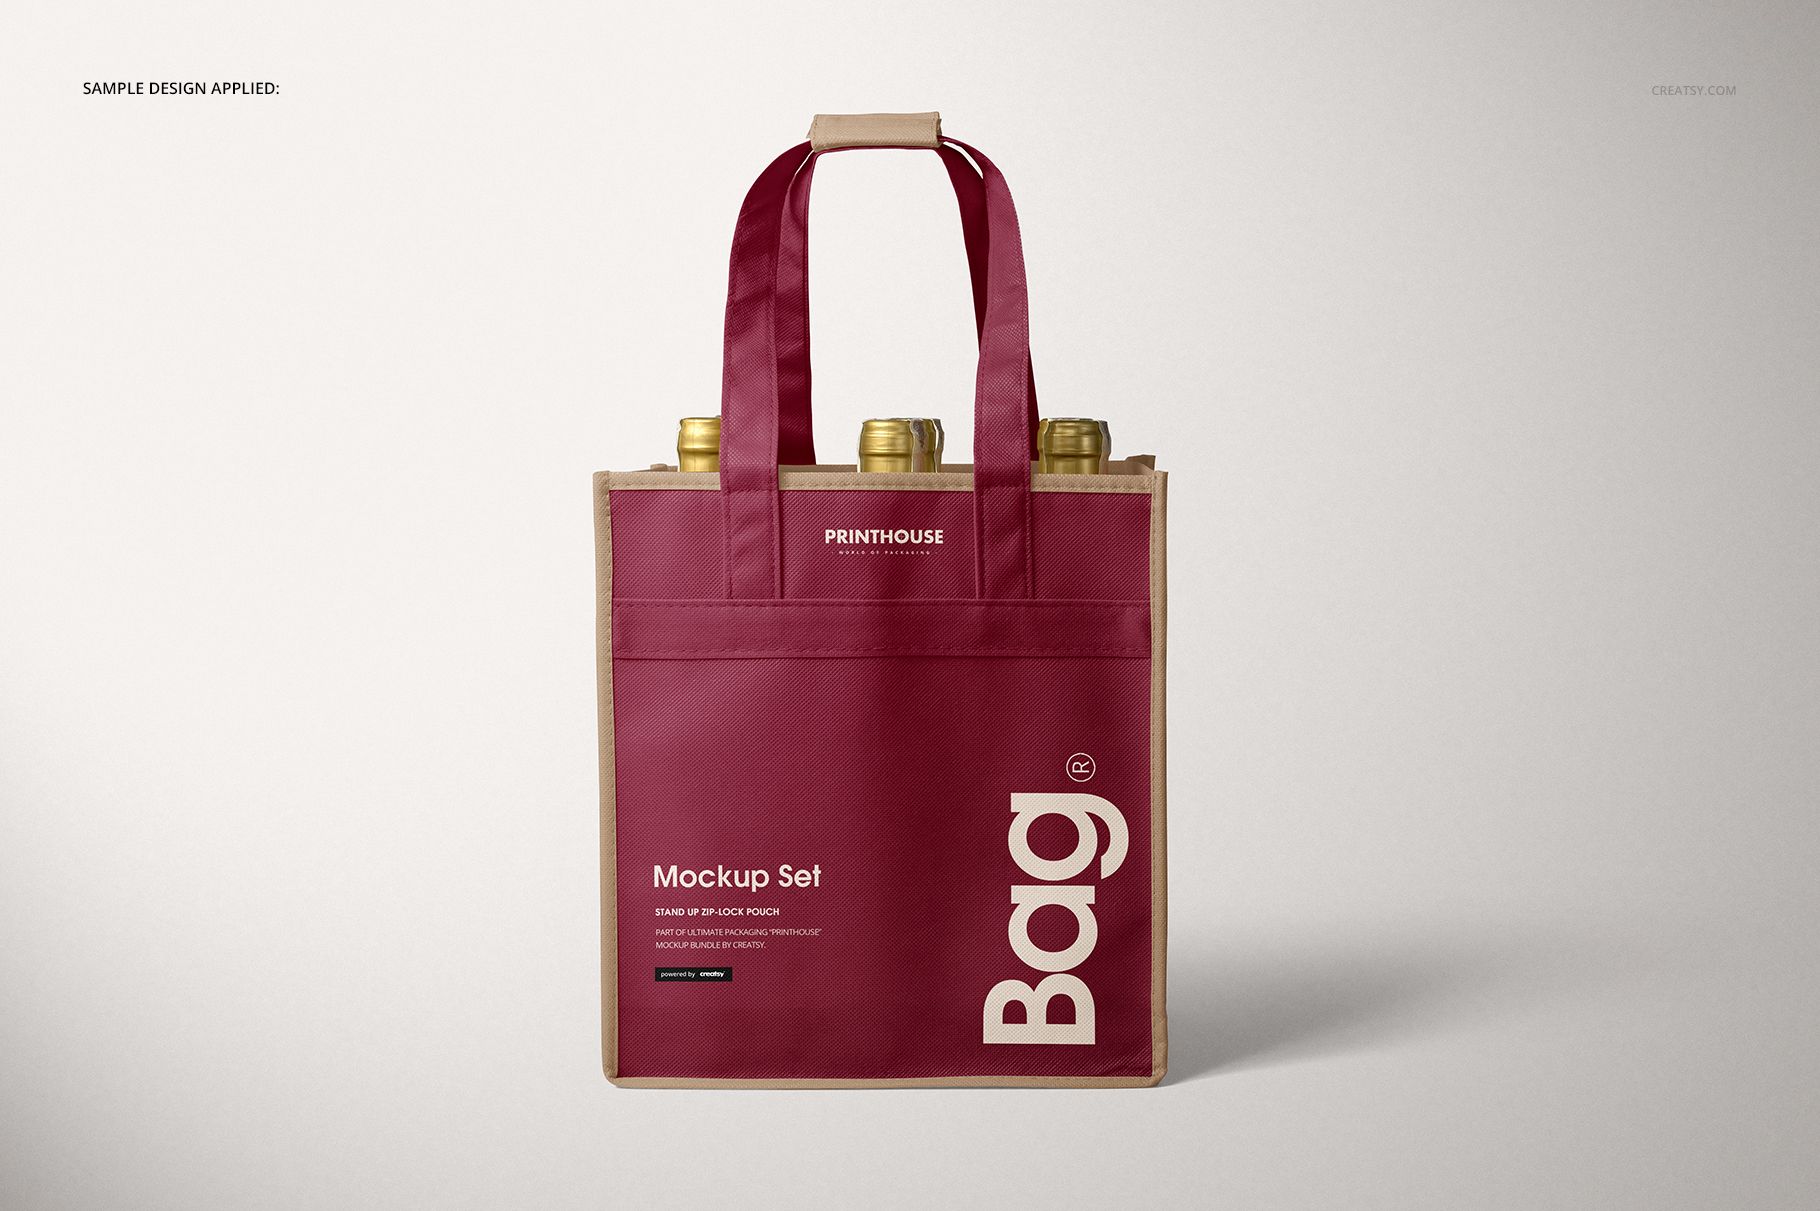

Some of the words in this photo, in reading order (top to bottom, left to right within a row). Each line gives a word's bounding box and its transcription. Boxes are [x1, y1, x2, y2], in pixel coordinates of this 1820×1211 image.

[824, 529, 944, 544] PRINTHOUSE
[653, 864, 770, 893] Mockup
[778, 864, 822, 888] Set
[655, 907, 685, 916] STAND
[687, 907, 700, 916] UP
[701, 907, 744, 916] ZIP-LOCK
[746, 907, 780, 916] POUCH
[983, 792, 1130, 1045] Bag
[655, 928, 674, 936] PART
[675, 928, 687, 936] OF
[687, 928, 724, 936] ULTIMATE
[724, 928, 768, 936] PACKAGING
[655, 941, 689, 949] MOCKUP
[690, 941, 721, 949] BUNDLE
[722, 941, 732, 949] BY
[733, 941, 766, 949] CREATSY.
[660, 970, 687, 978] powered
[687, 970, 696, 979] by
